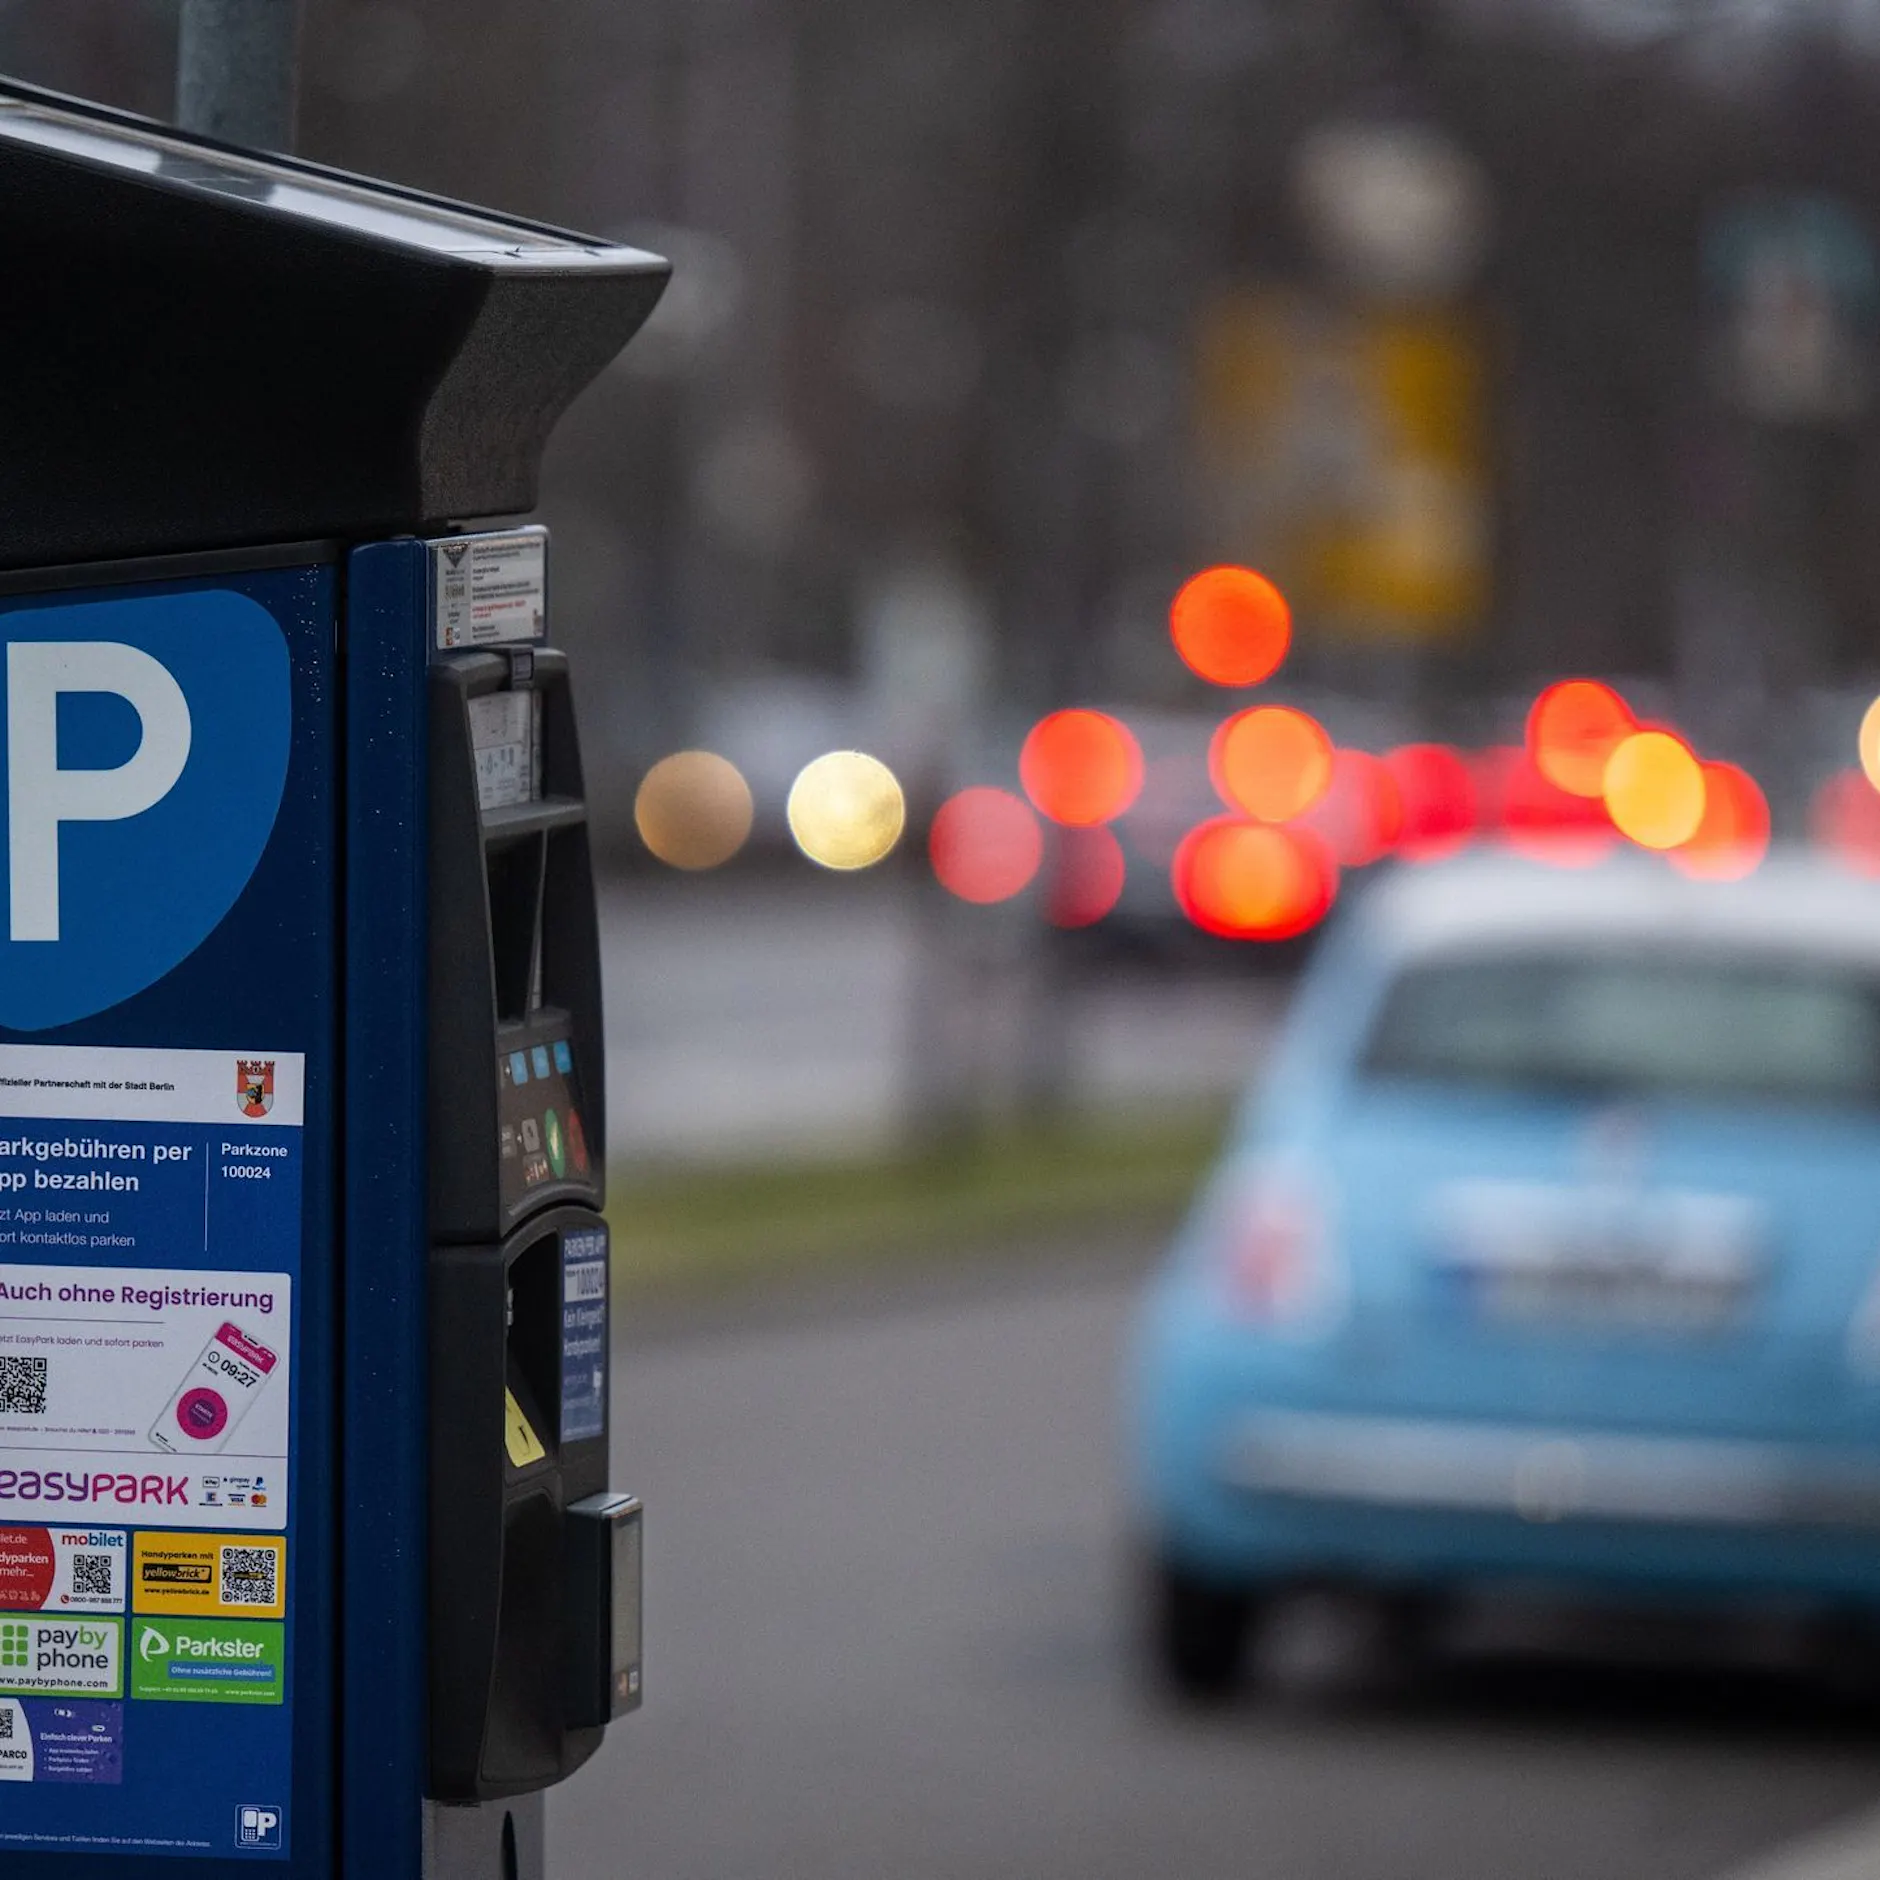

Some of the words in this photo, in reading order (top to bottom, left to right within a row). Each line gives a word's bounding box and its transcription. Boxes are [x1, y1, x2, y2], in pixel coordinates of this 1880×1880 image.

[7, 642, 191, 941] P
[33, 1079, 91, 1089] Partnerschaft
[93, 1080, 106, 1089] mit
[109, 1081, 122, 1090] der
[125, 1081, 147, 1090] Stadt
[149, 1082, 175, 1091] Berlin
[153, 1144, 192, 1164] per
[221, 1142, 288, 1157] Parkzone
[34, 1169, 139, 1191] bezahlen
[221, 1166, 271, 1179] 100024
[14, 1209, 41, 1224] App
[45, 1210, 81, 1222] laden
[84, 1211, 109, 1224] und
[20, 1231, 87, 1245] kontaktlos
[90, 1233, 135, 1247] parken
[0, 1281, 51, 1301] Auch
[58, 1283, 115, 1303] ohne
[121, 1285, 274, 1314] Registrierung
[15, 1335, 55, 1346] EasyPark
[56, 1336, 82, 1345] laden
[84, 1338, 102, 1346] und
[104, 1338, 130, 1347] sofort
[132, 1339, 164, 1348] parken
[220, 1359, 257, 1388] 09:27
[62, 1532, 124, 1547] mobilet
[141, 1551, 198, 1560] Handyparken
[200, 1552, 214, 1560] mit
[144, 1567, 200, 1579] yellowbrick
[144, 1587, 210, 1595] www.yellowbrick.de
[176, 1635, 264, 1658] Parkster
[37, 1648, 109, 1671] phone
[171, 1666, 191, 1674] Ohne
[192, 1666, 232, 1676] zusätzliche
[233, 1668, 272, 1677] Gebühren!
[88, 1734, 112, 1743] Parken
